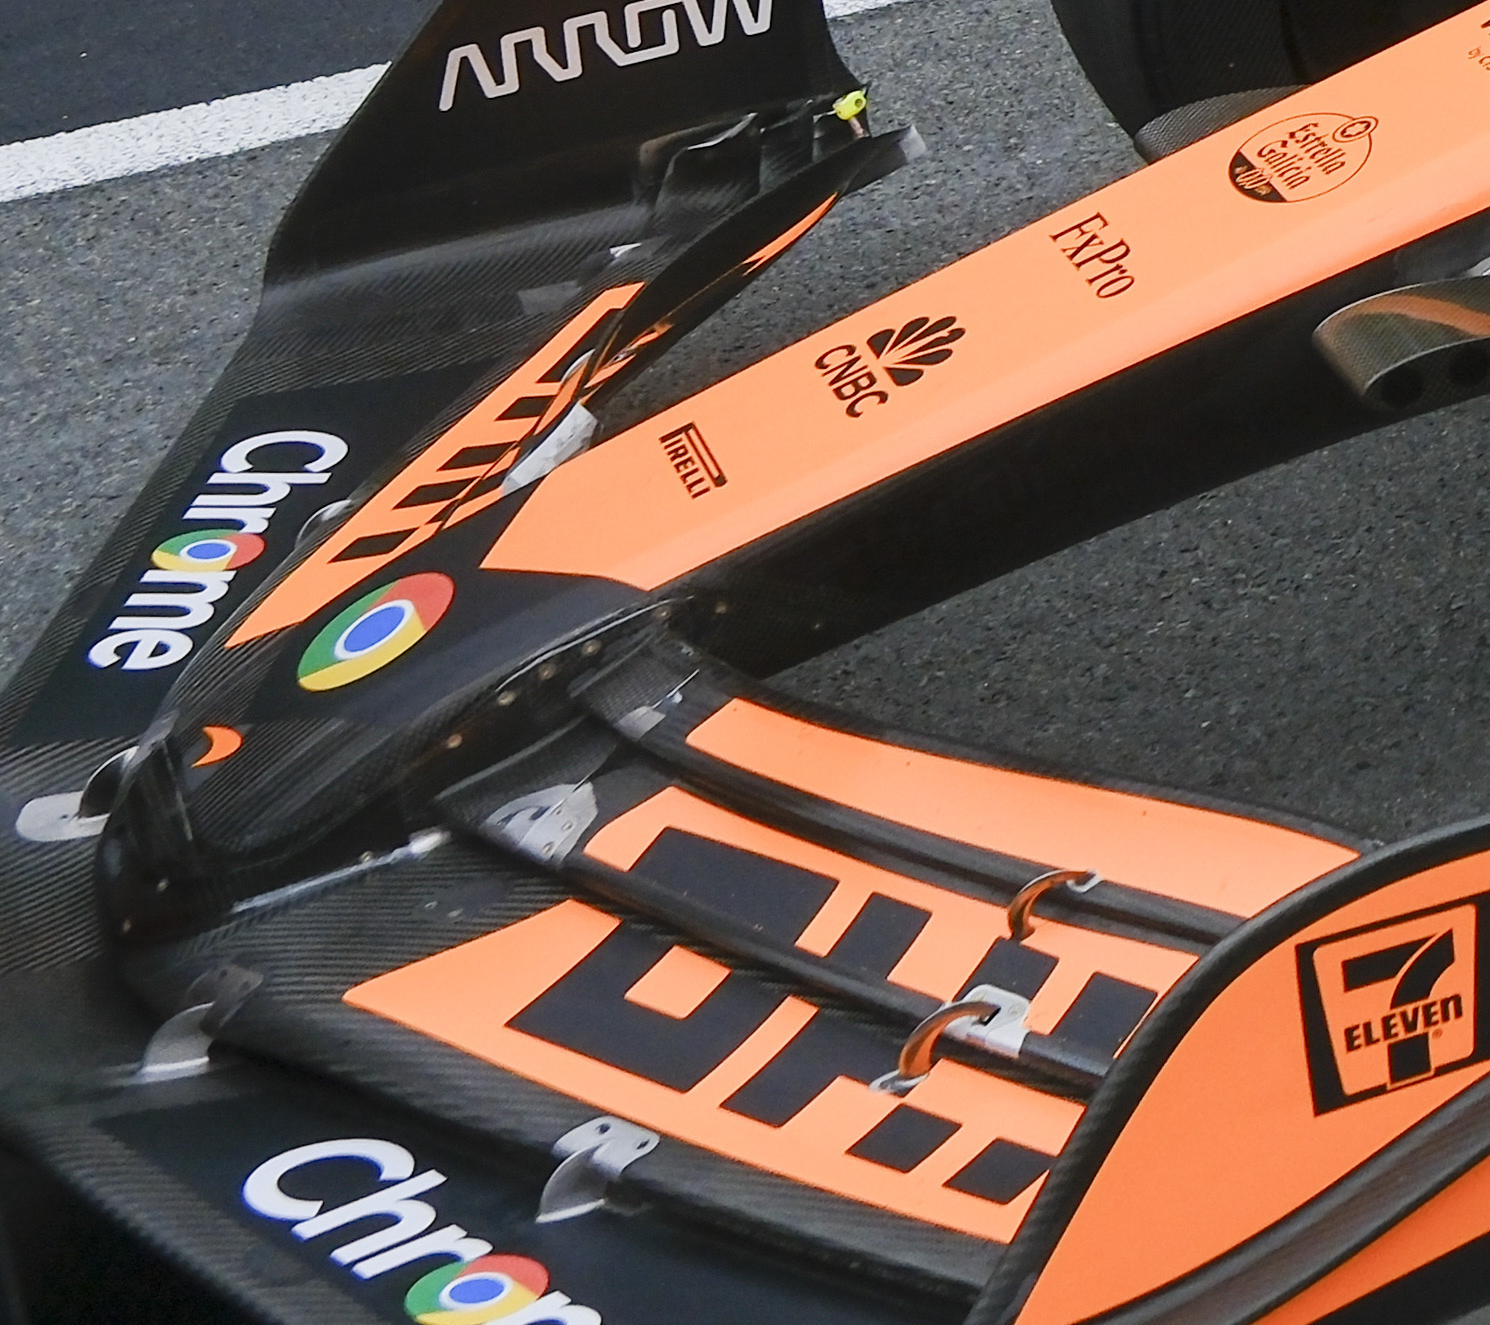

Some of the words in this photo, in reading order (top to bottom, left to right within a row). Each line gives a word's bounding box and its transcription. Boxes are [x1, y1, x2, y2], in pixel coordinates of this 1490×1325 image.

[1256, 139, 1313, 191] Galicia
[1288, 122, 1347, 176] Estrella
[1049, 212, 1137, 301] FxPro
[813, 343, 890, 419] CNBC
[659, 422, 728, 500] PIRELLI
[85, 428, 350, 673] Chrome
